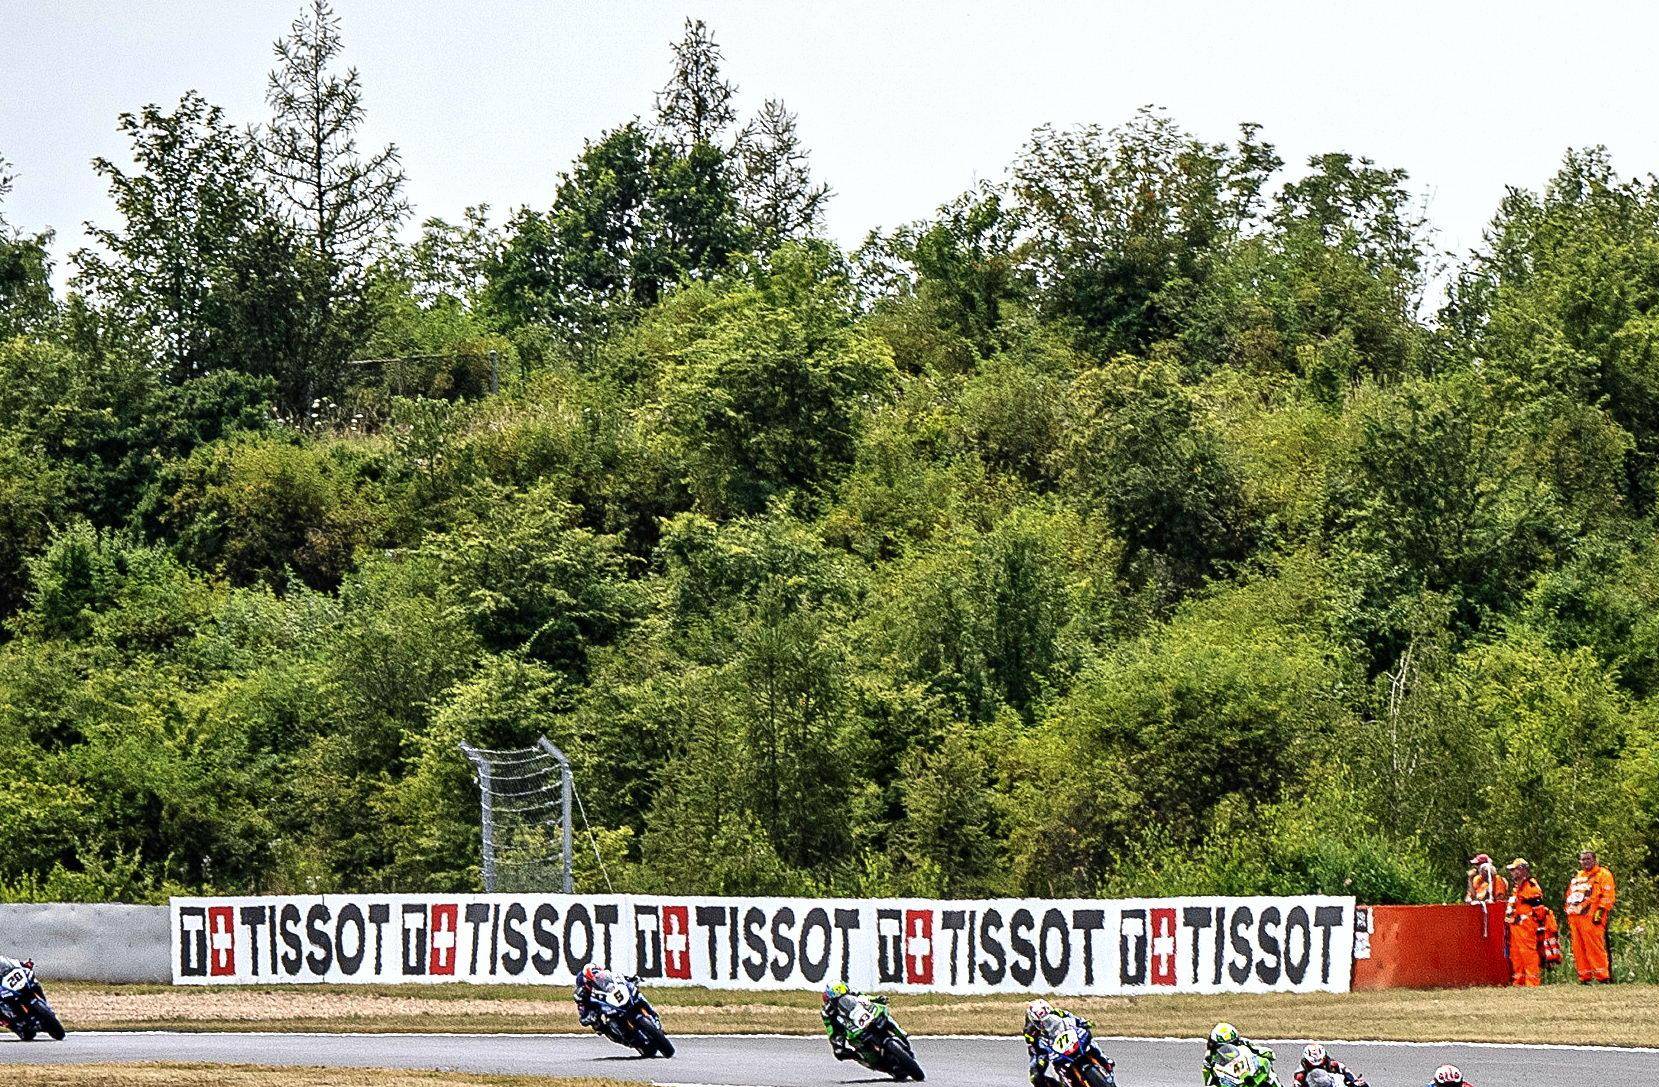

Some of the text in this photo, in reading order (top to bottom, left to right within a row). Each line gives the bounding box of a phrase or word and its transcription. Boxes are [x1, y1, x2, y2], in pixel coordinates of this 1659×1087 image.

[240, 904, 389, 976] TISSOT
[465, 903, 618, 976] TISSOT
[699, 906, 860, 983] TISSOT
[942, 908, 1104, 987] TISSOT
[1183, 906, 1343, 985] TISSOT
[1056, 1034, 1070, 1049] 77
